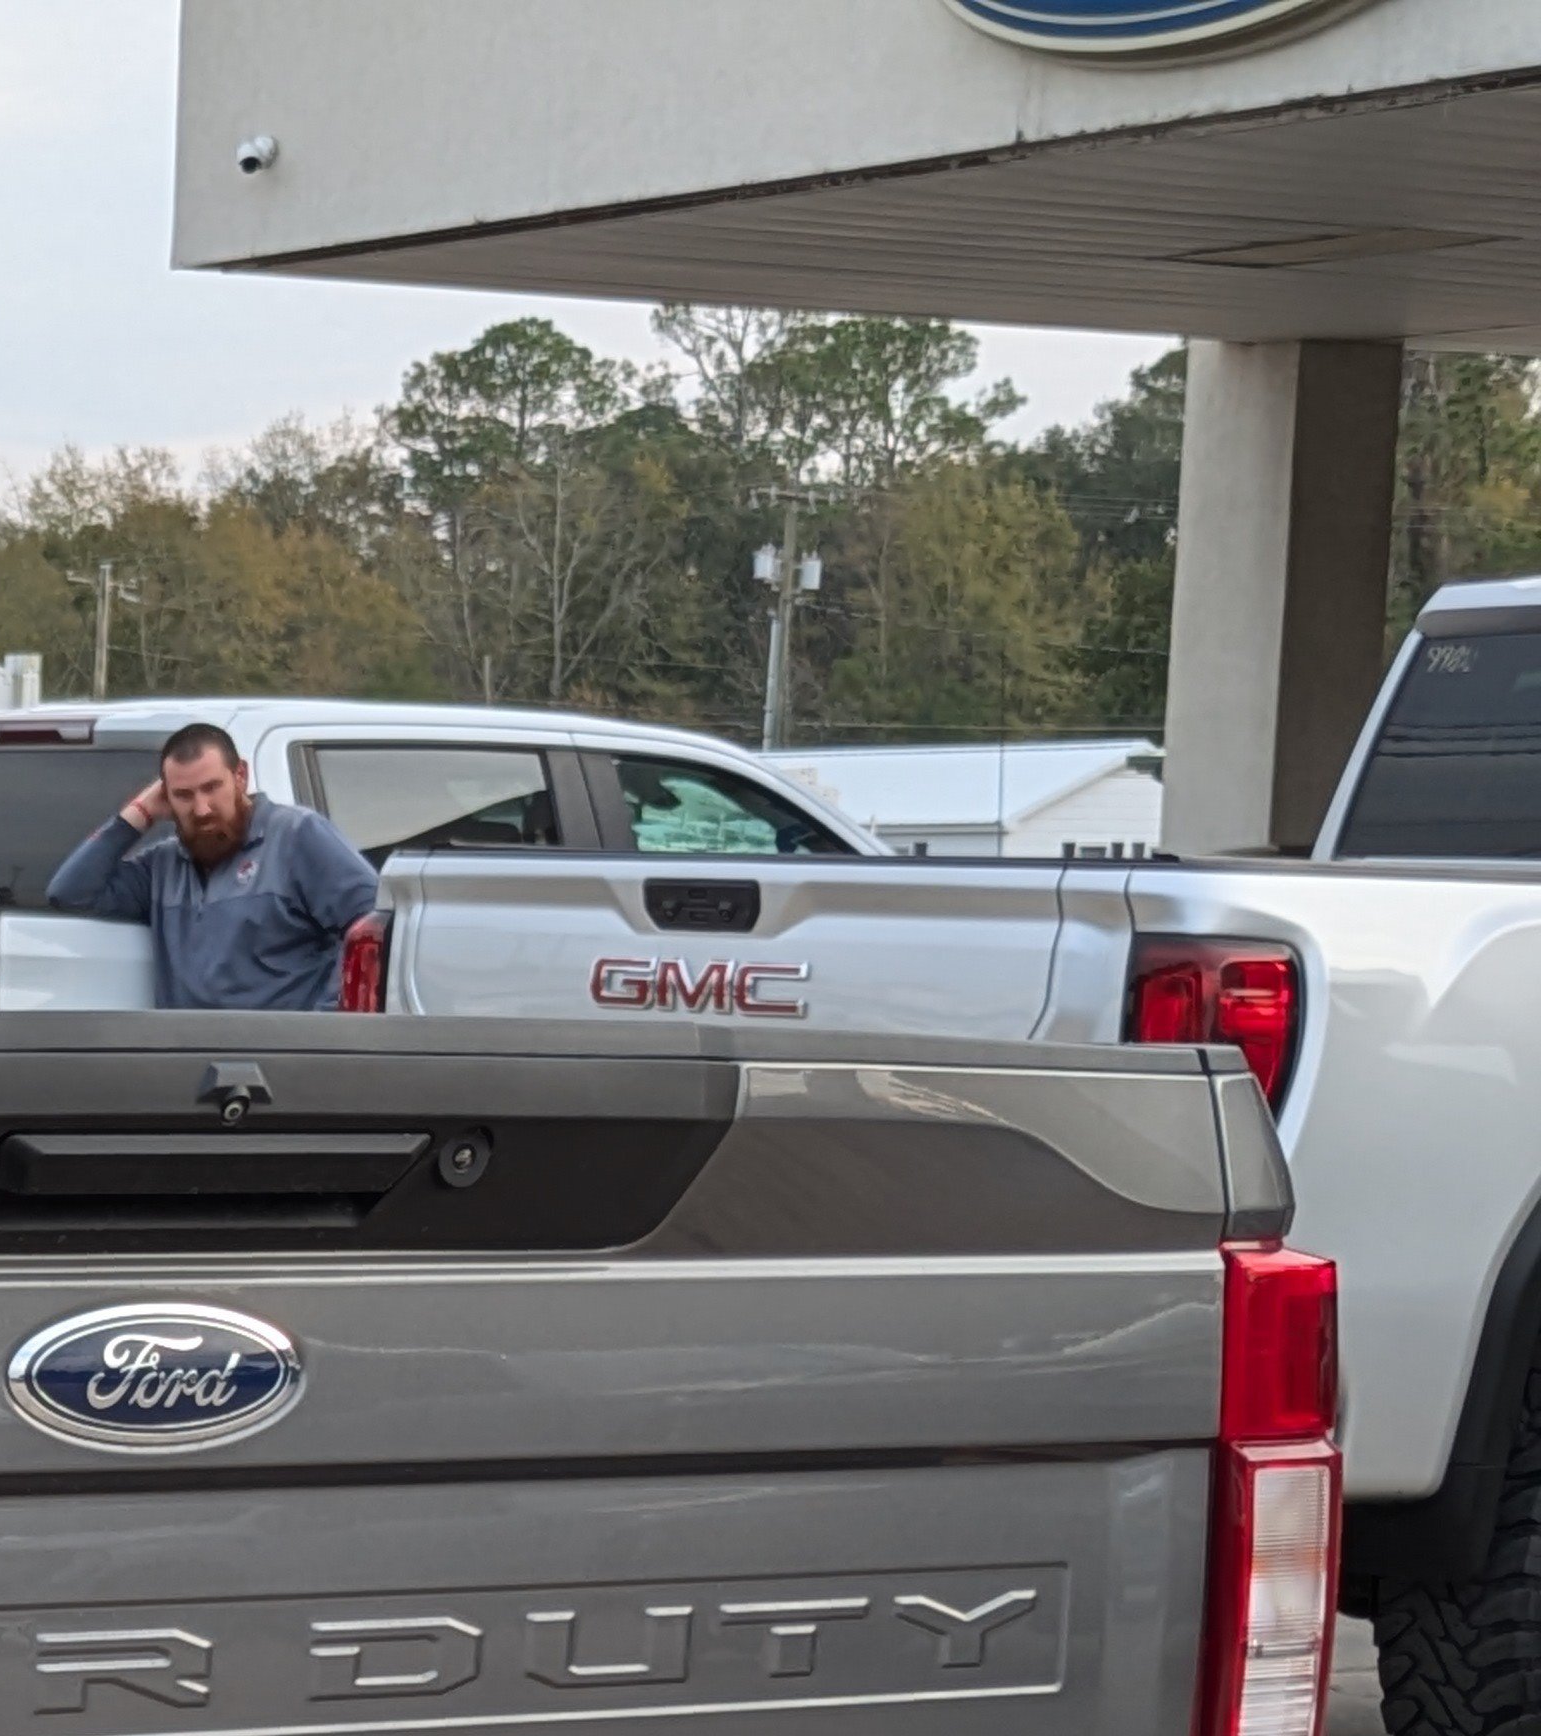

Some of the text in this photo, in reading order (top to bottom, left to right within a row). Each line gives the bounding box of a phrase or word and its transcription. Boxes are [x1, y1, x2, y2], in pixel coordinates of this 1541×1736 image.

[589, 957, 812, 1018] GMC
[86, 1333, 241, 1410] Ford
[309, 1588, 1038, 1702] DUTY
